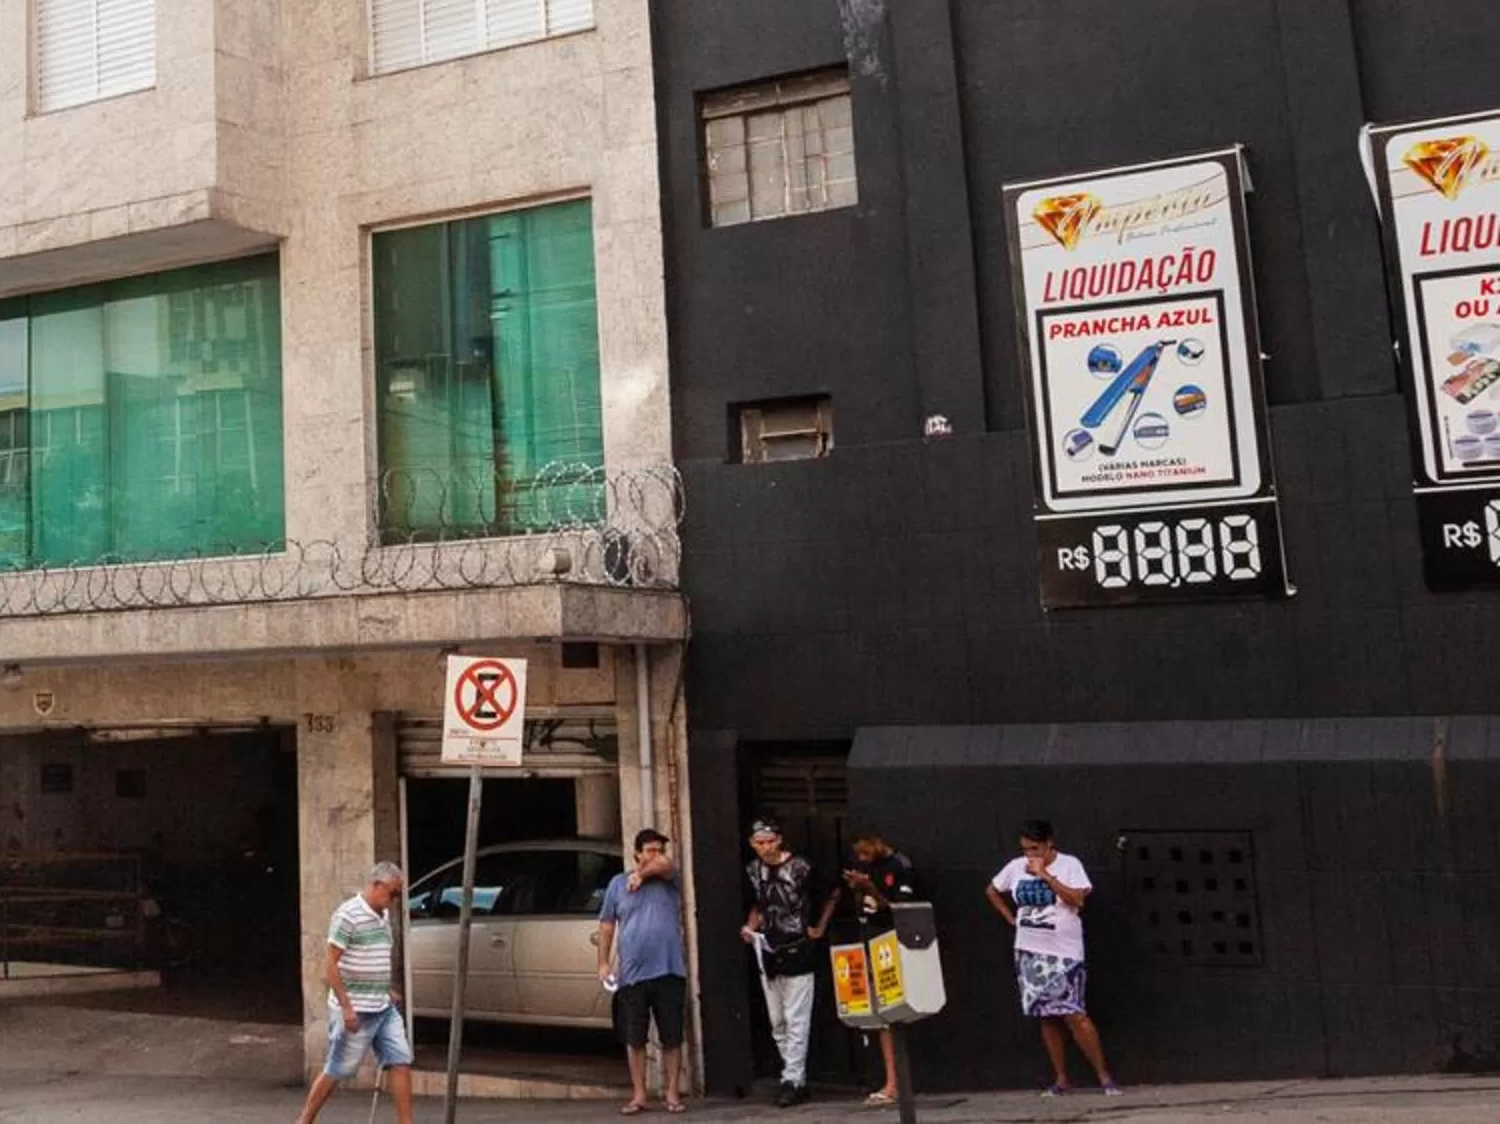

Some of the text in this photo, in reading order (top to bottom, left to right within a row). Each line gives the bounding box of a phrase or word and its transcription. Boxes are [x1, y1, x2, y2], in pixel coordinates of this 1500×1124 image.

[1043, 247, 1217, 303] LIQUIDAÇÃO
[1455, 299, 1489, 318] OU
[1049, 307, 1213, 340] PRANCHA AZUL
[1443, 521, 1482, 548] R$
[1057, 545, 1091, 571] R$
